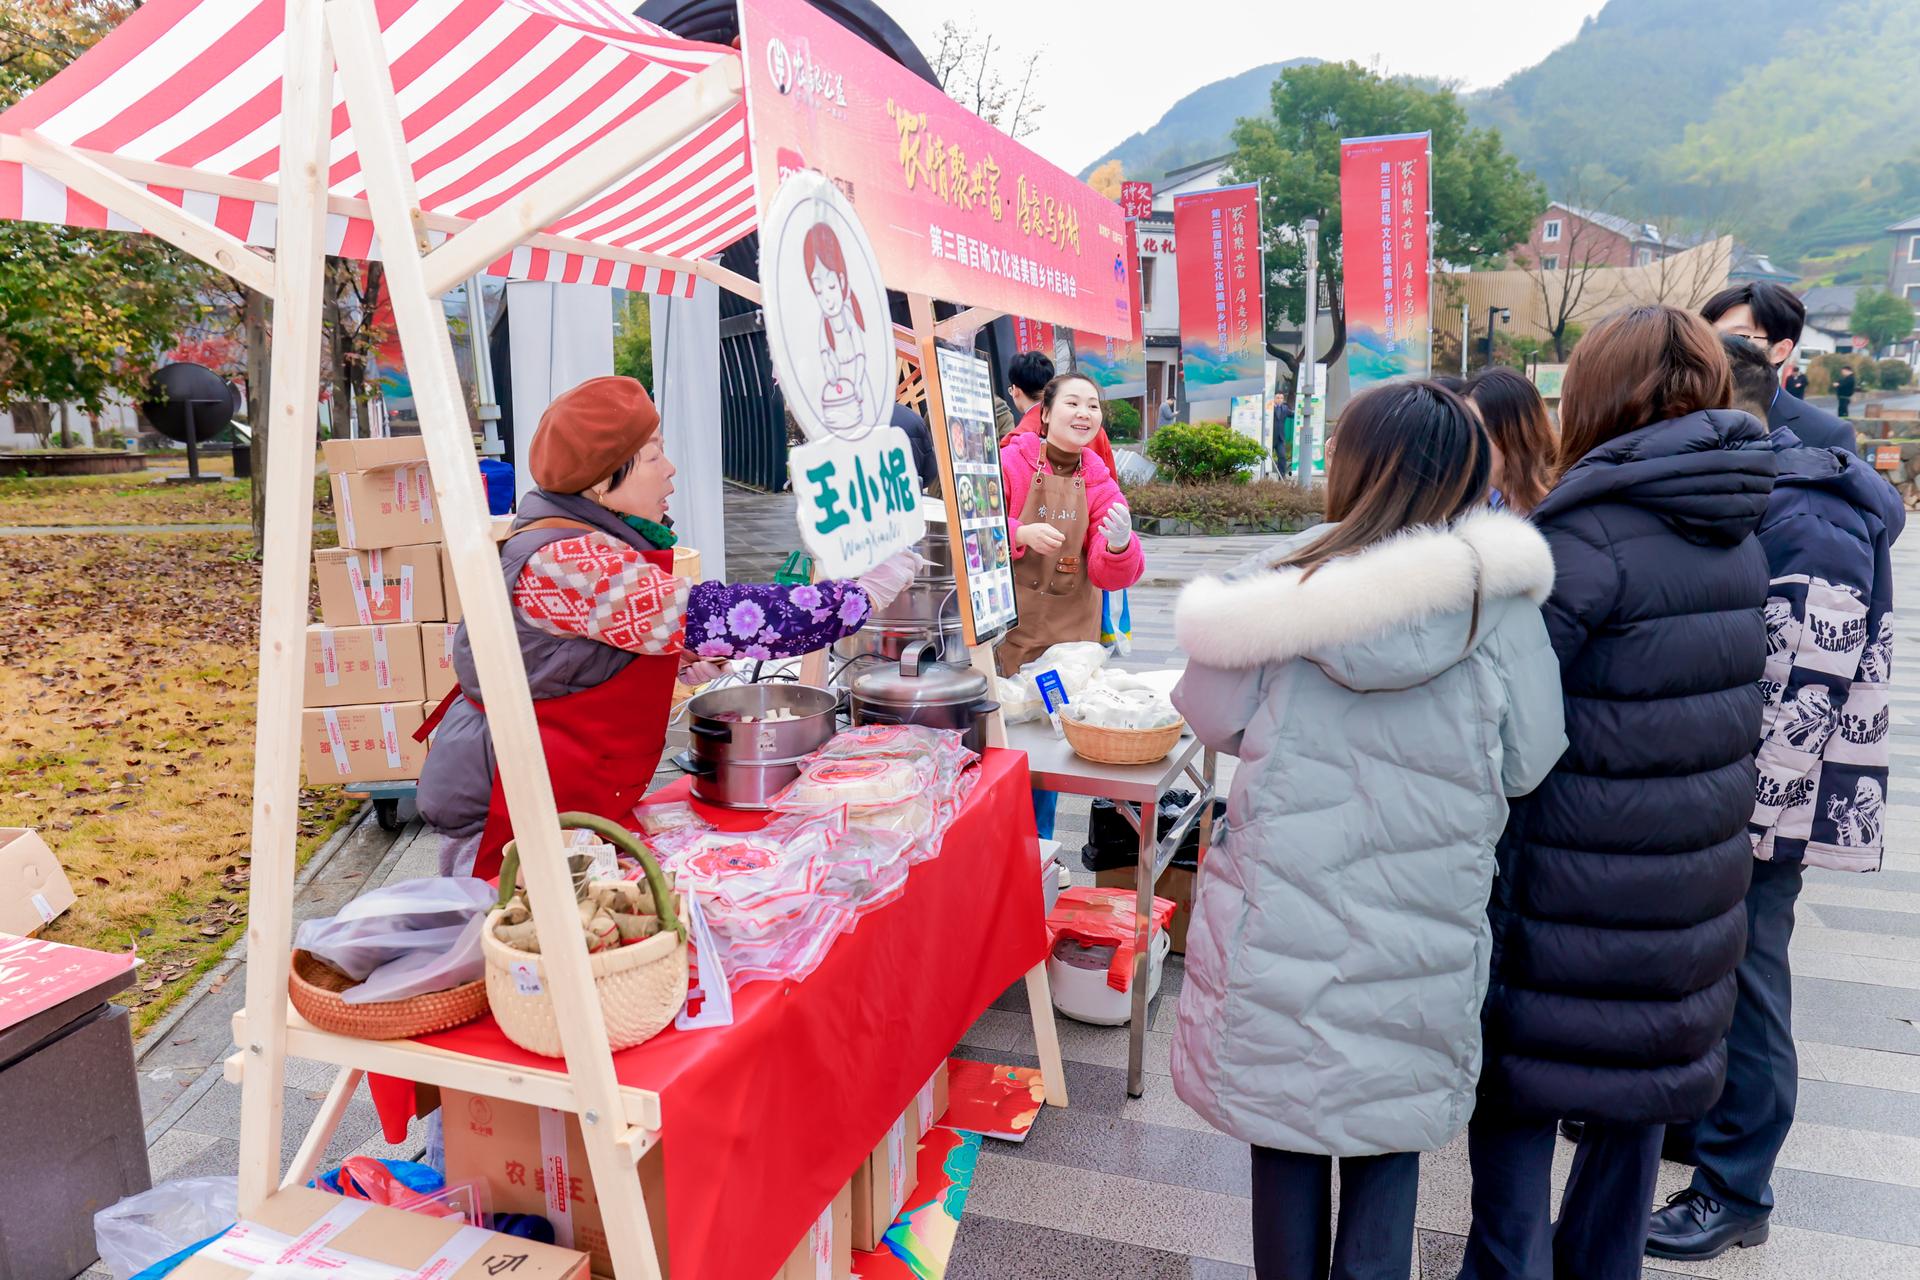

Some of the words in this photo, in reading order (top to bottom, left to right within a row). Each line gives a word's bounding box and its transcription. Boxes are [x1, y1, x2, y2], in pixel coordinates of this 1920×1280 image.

[929, 223, 1078, 298] 第三届百场文化送美丽乡村启动会
[806, 448, 915, 534] 王小妮
[1809, 613, 1837, 638] It's
